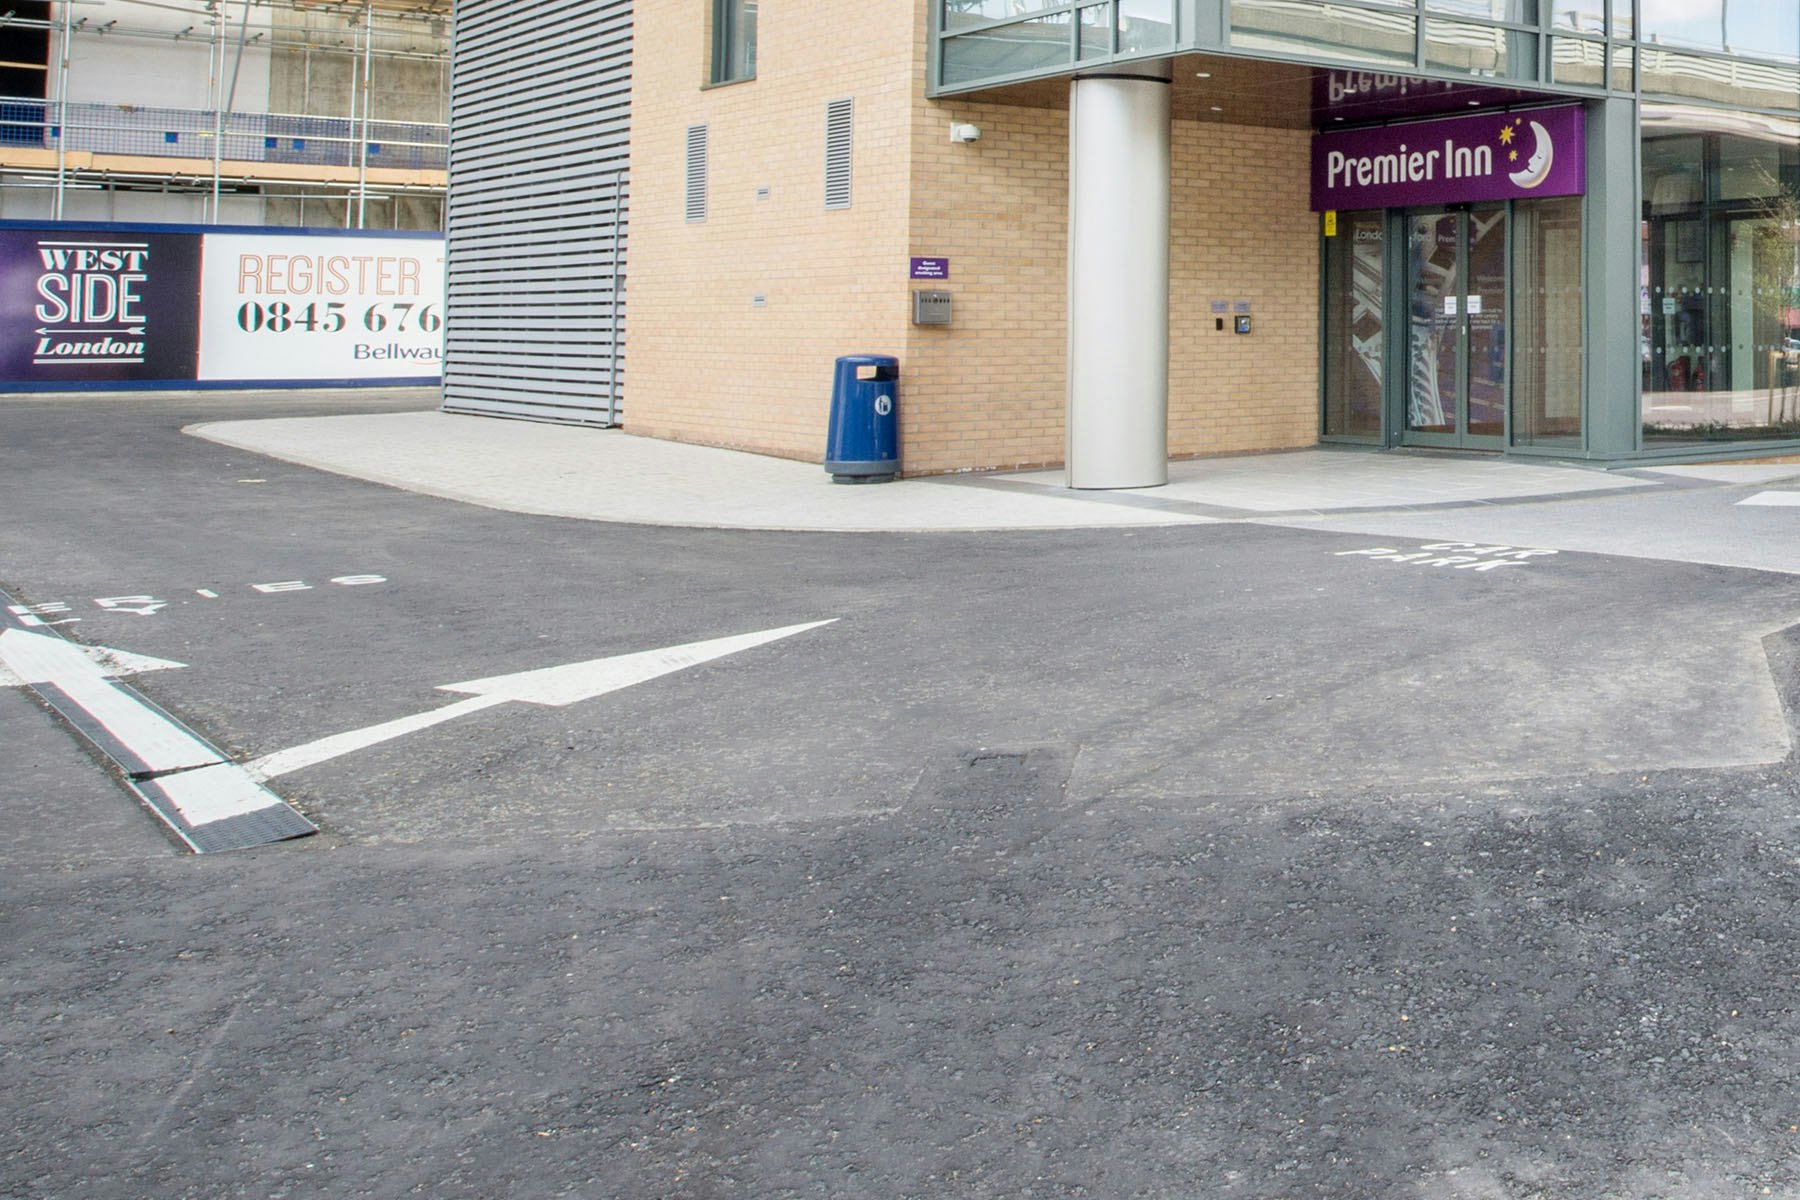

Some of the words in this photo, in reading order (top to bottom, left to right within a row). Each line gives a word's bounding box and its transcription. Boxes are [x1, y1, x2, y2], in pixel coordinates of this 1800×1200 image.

[1327, 144, 1440, 188] Premier
[1445, 139, 1492, 179] Inn
[38, 249, 149, 271] WEST
[238, 254, 421, 296] REGISTER
[35, 273, 148, 323] SIDE
[238, 302, 346, 333] 0845
[364, 302, 442, 333] 676
[34, 337, 145, 355] London
[1333, 547, 1531, 572] PARK
[1420, 542, 1559, 559] CAR
